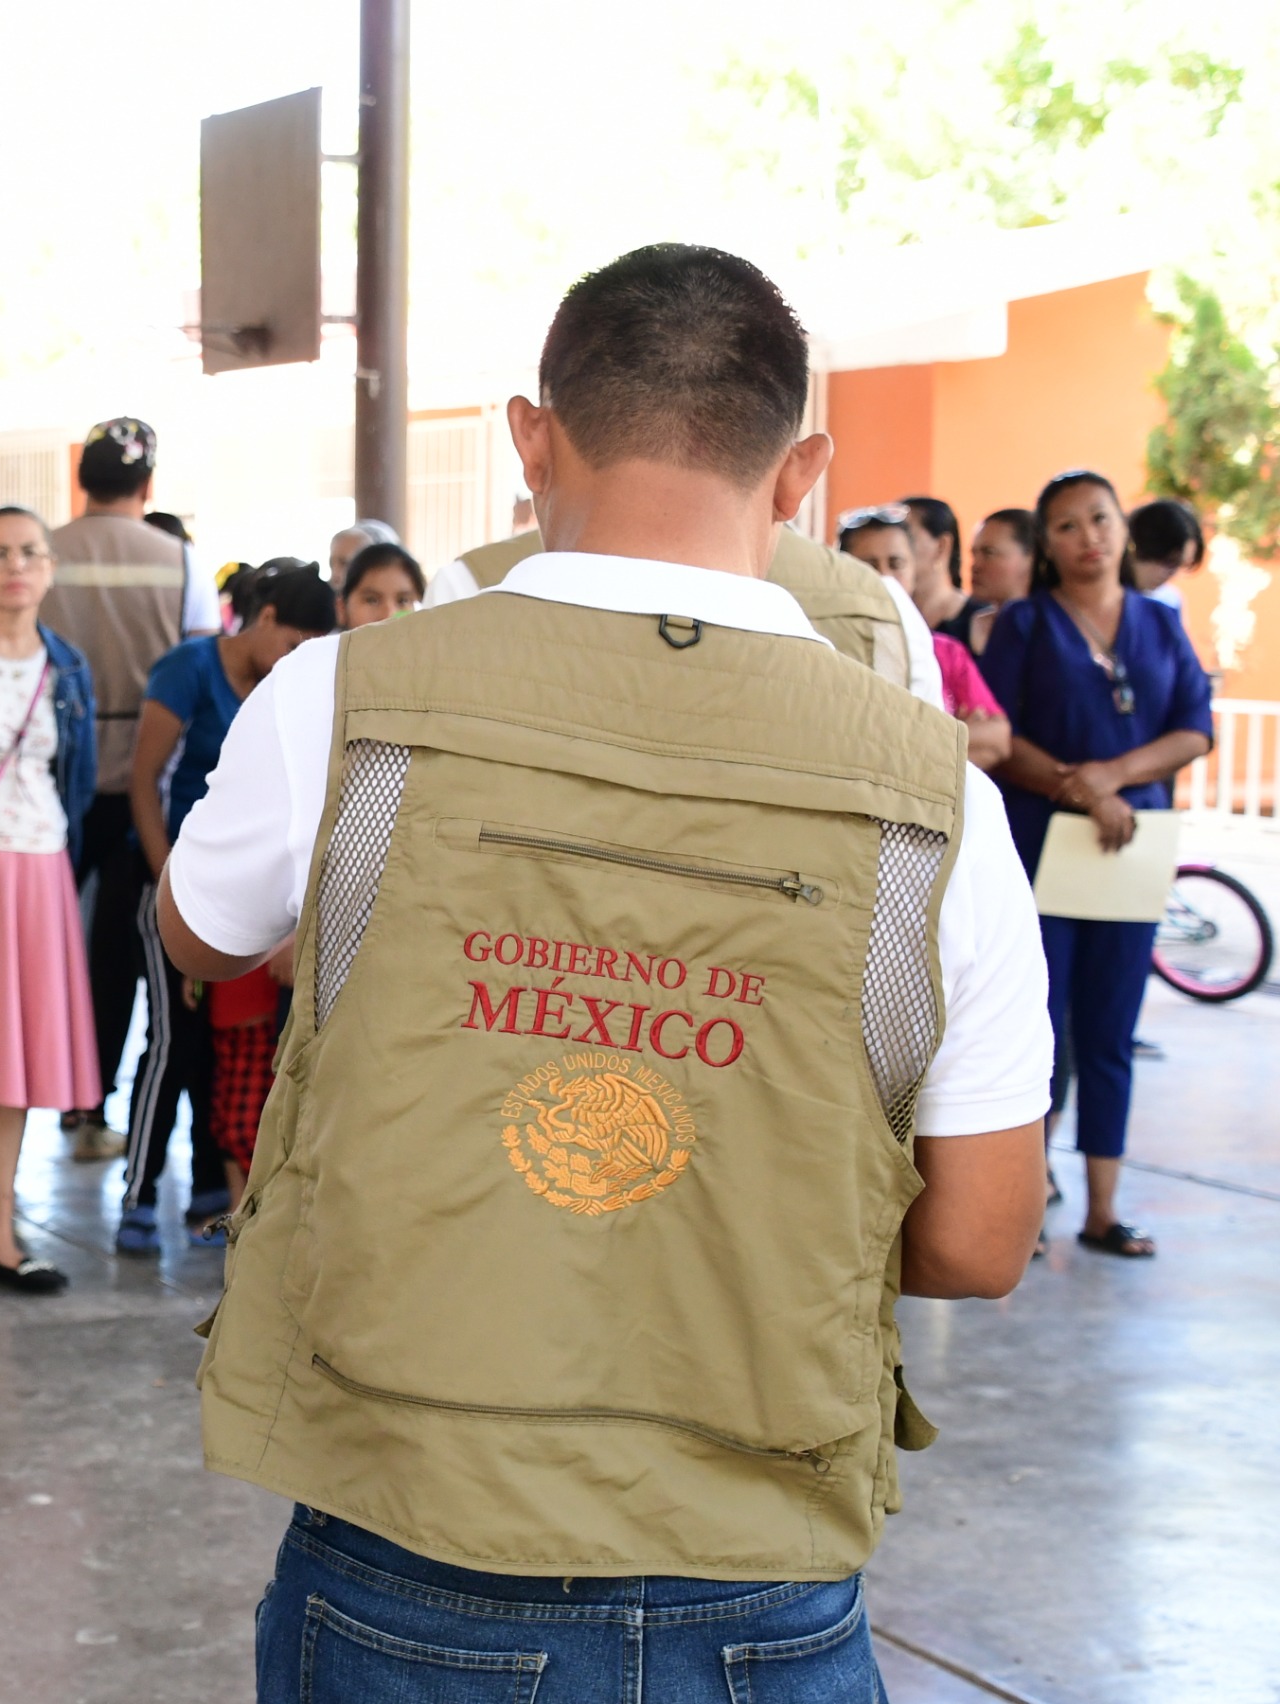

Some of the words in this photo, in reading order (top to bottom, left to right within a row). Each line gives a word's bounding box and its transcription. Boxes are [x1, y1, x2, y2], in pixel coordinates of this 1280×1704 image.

[463, 930, 687, 989] GOBIERNO
[702, 966, 766, 1006] DE
[461, 976, 744, 1067] MÉXICO
[500, 1061, 561, 1119] ESTADOS
[562, 1052, 631, 1074] UNIDOS
[632, 1065, 696, 1144] MEXICANOS
